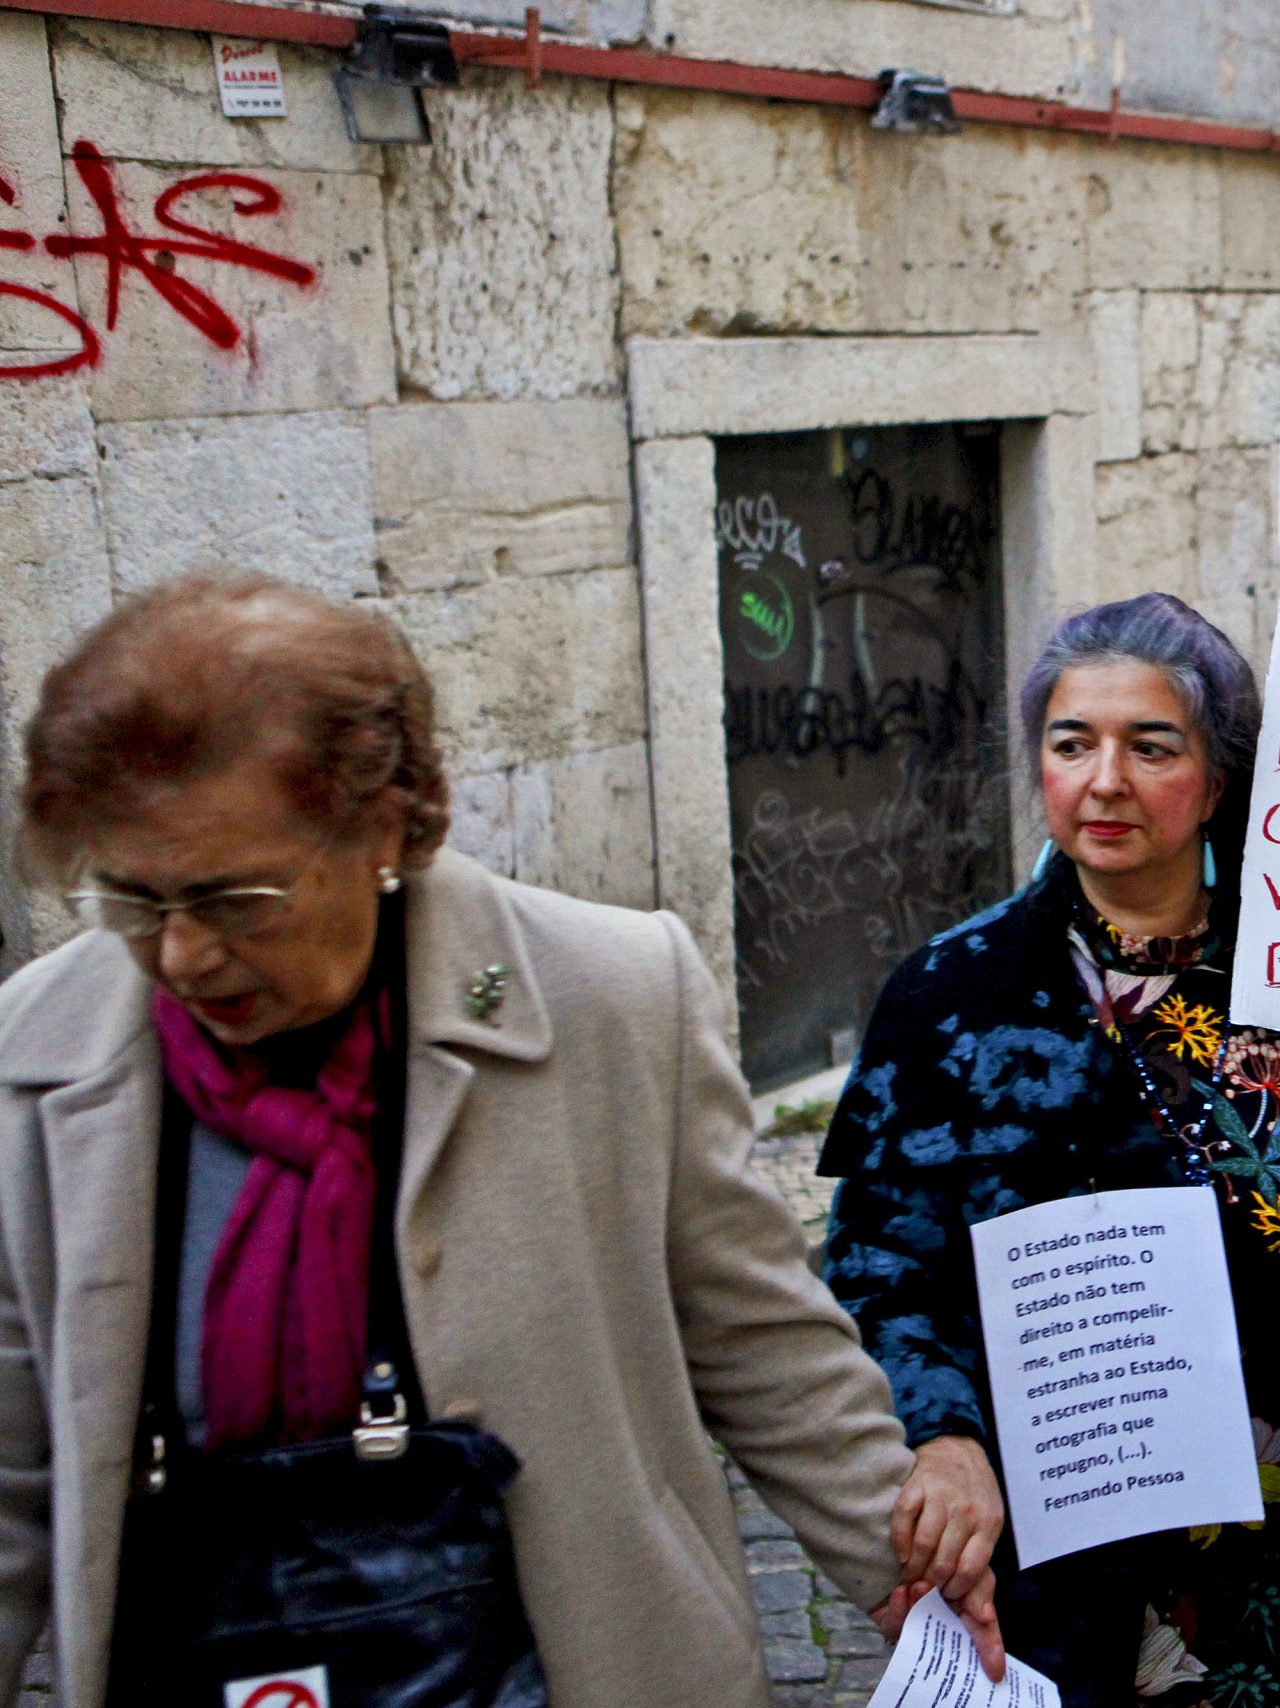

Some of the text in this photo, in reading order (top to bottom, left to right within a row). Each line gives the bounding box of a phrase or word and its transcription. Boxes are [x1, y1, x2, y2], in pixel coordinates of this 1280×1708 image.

[1008, 1222, 1166, 1262] O Estado nada tem
[1011, 1249, 1154, 1290] com o espírito. O
[1015, 1279, 1146, 1317] Estado não tem
[1019, 1304, 1174, 1345] direito a compelir-
[1058, 1346, 1085, 1363] em
[1089, 1332, 1155, 1356] matéria
[1027, 1357, 1193, 1399] estranha ao Estado,
[1031, 1386, 1169, 1427] a escrever numa
[1035, 1415, 1154, 1454] ortografia que
[1039, 1451, 1114, 1482] repugno,
[1044, 1469, 1185, 1513] Fernando Pessoa
